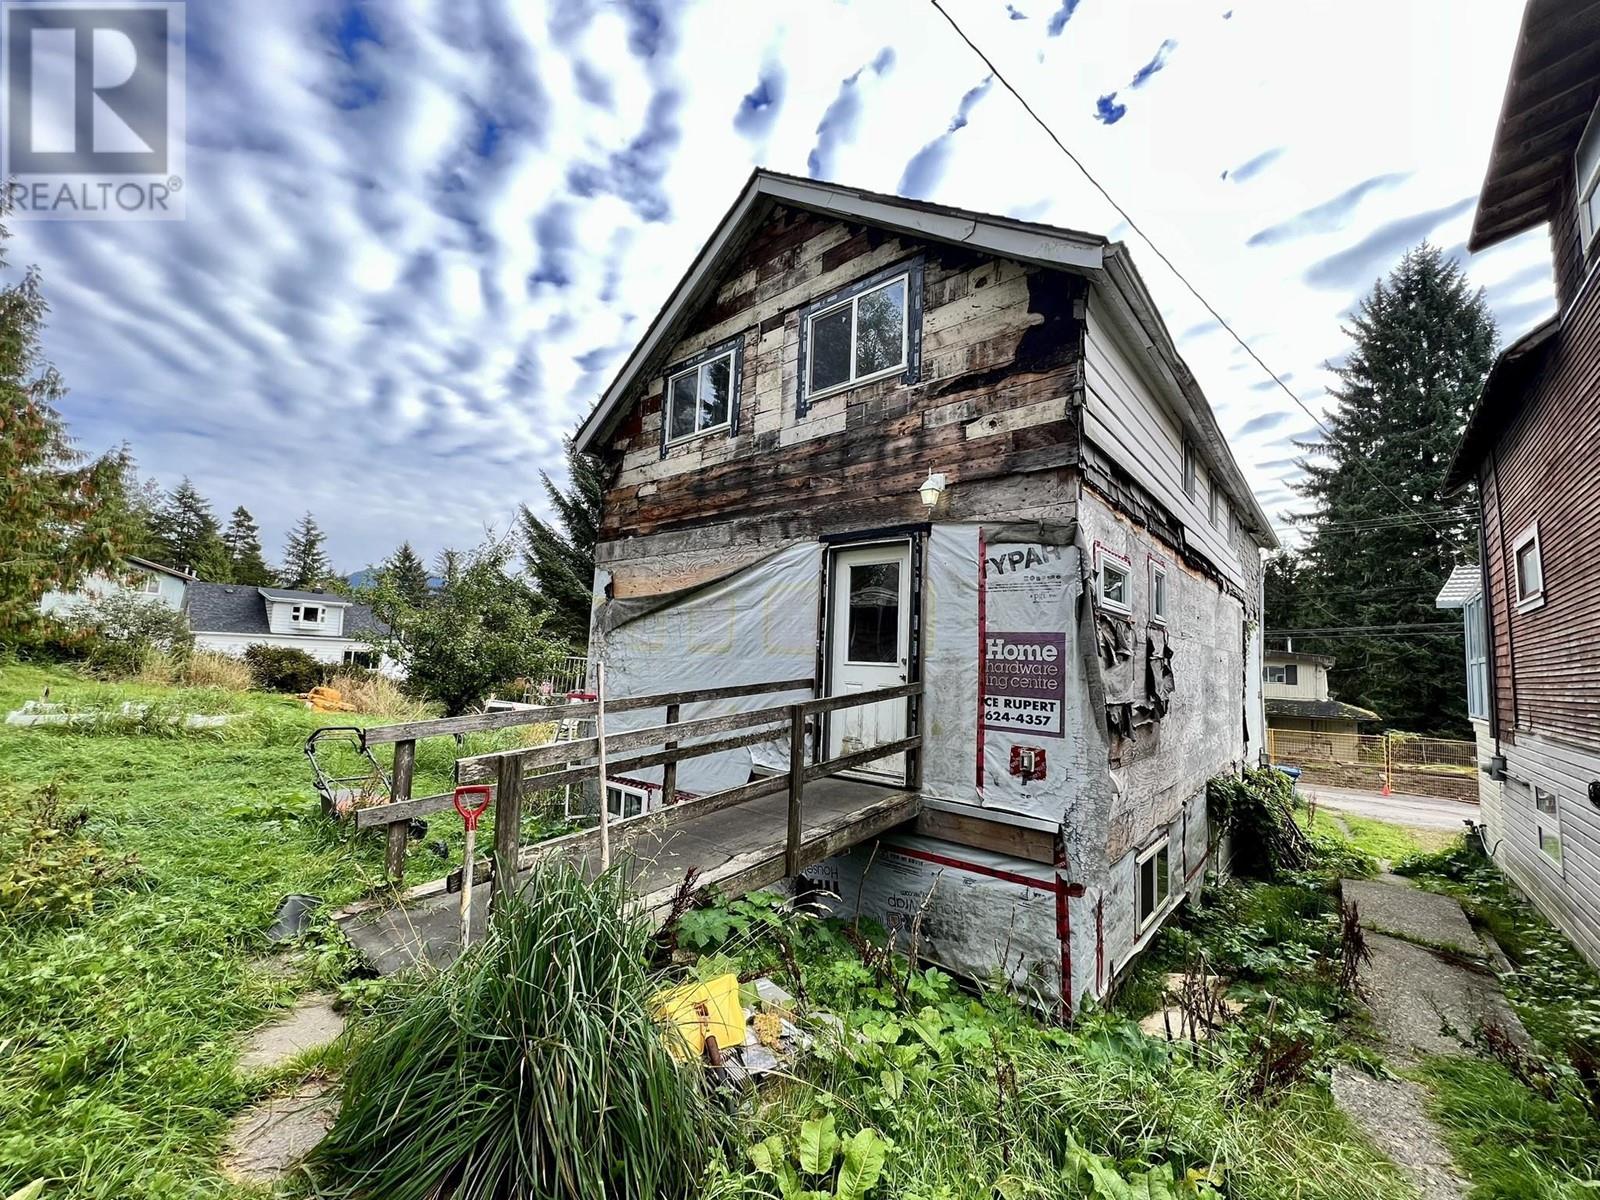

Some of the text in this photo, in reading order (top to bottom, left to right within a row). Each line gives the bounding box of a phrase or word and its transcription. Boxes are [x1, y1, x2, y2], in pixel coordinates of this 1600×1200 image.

[986, 638, 1058, 662] Home
[986, 660, 1058, 676] hardware
[1011, 676, 1058, 690] centre
[1003, 698, 1056, 713] RUPERT
[985, 710, 1052, 727] 624-4357
